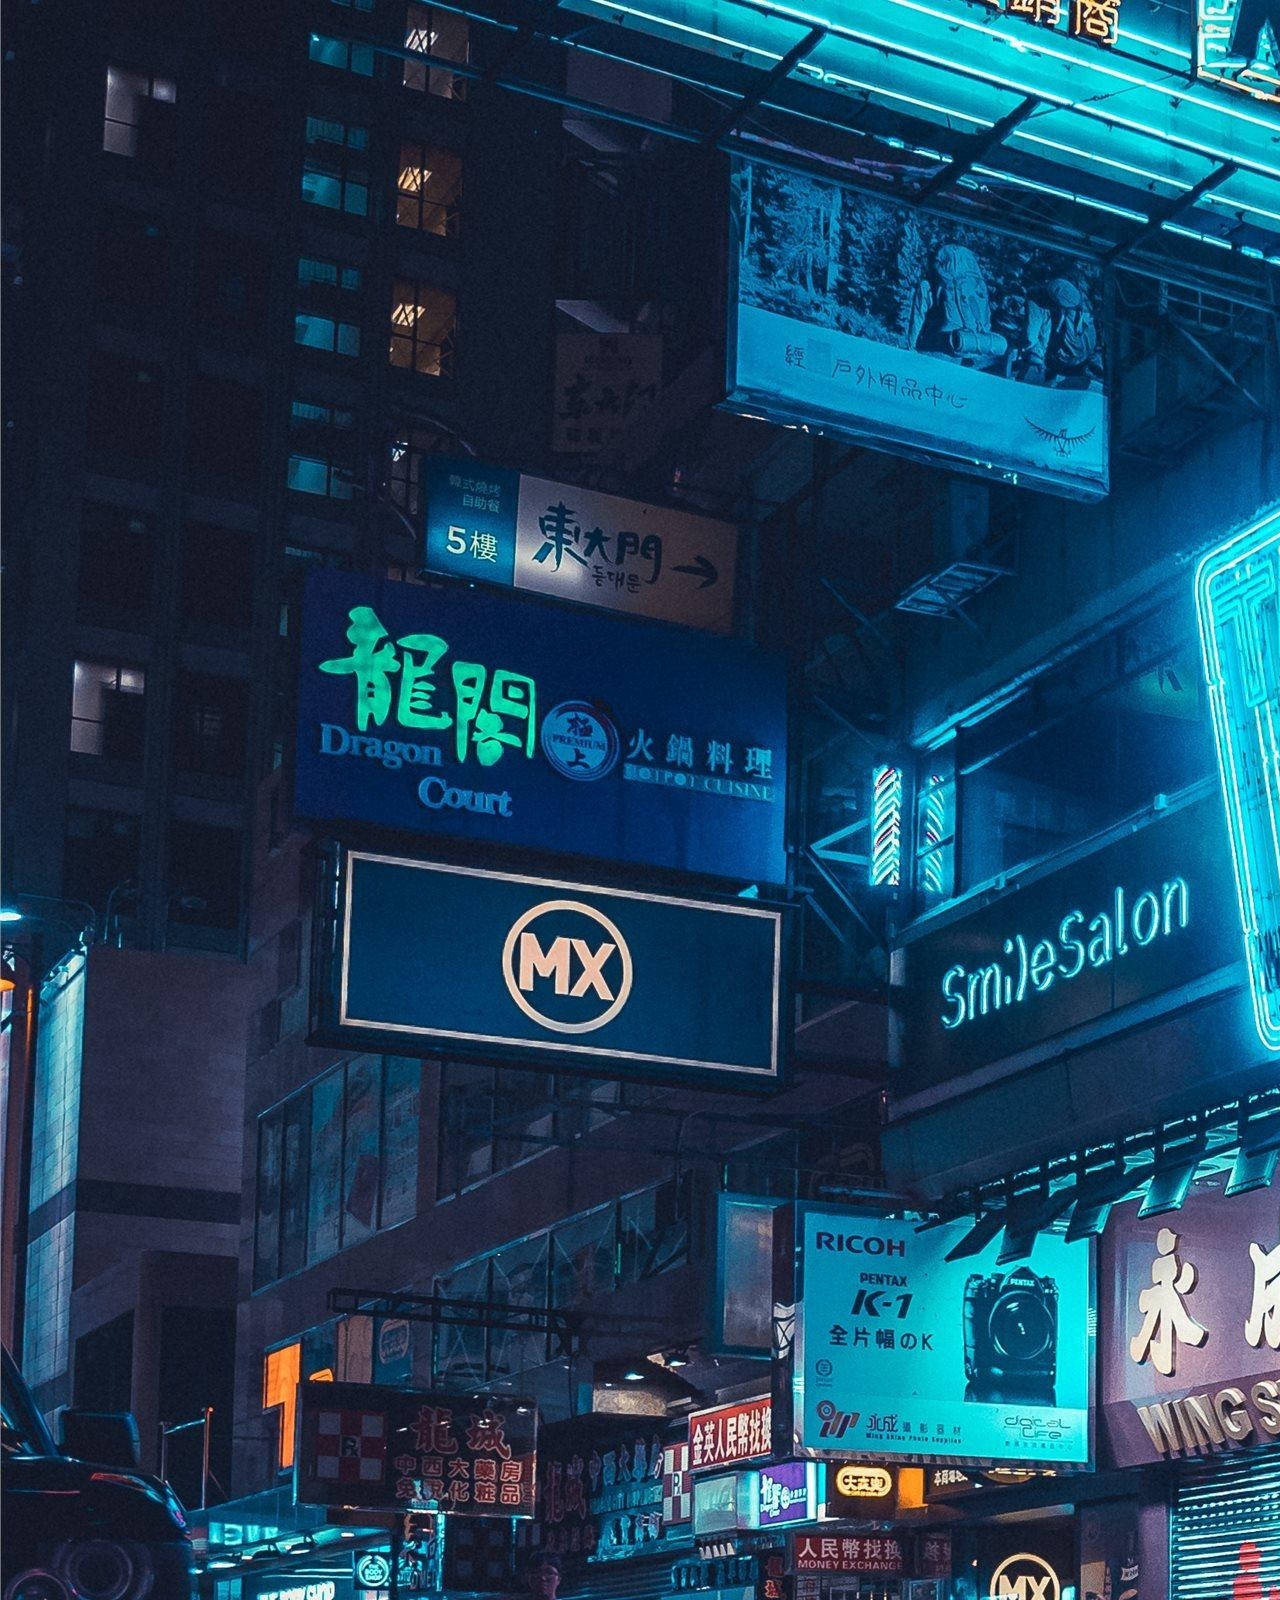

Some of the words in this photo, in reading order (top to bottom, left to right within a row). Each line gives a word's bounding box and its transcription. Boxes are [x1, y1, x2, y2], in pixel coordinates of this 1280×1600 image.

[446, 524, 498, 563] 5樓
[531, 500, 663, 584] 東大門
[320, 723, 443, 769] Dragon
[552, 733, 606, 751] PREMIUM
[627, 728, 773, 779] 火鍋料理
[418, 776, 513, 817] Court
[704, 777, 776, 802] CUISINE
[519, 931, 617, 1002] MX
[816, 1231, 906, 1257] RICOH
[859, 1272, 908, 1288] PENTAX
[1010, 1277, 1036, 1288] PENTAX
[850, 1288, 915, 1319] K-1
[828, 1324, 934, 1351] 全片幅のK
[1137, 1388, 1252, 1460] WING
[798, 1537, 902, 1560] 人民幣找換
[797, 1560, 840, 1569] MONEY
[842, 1560, 903, 1571] EXCHANGE
[998, 1574, 1052, 1600] MX
